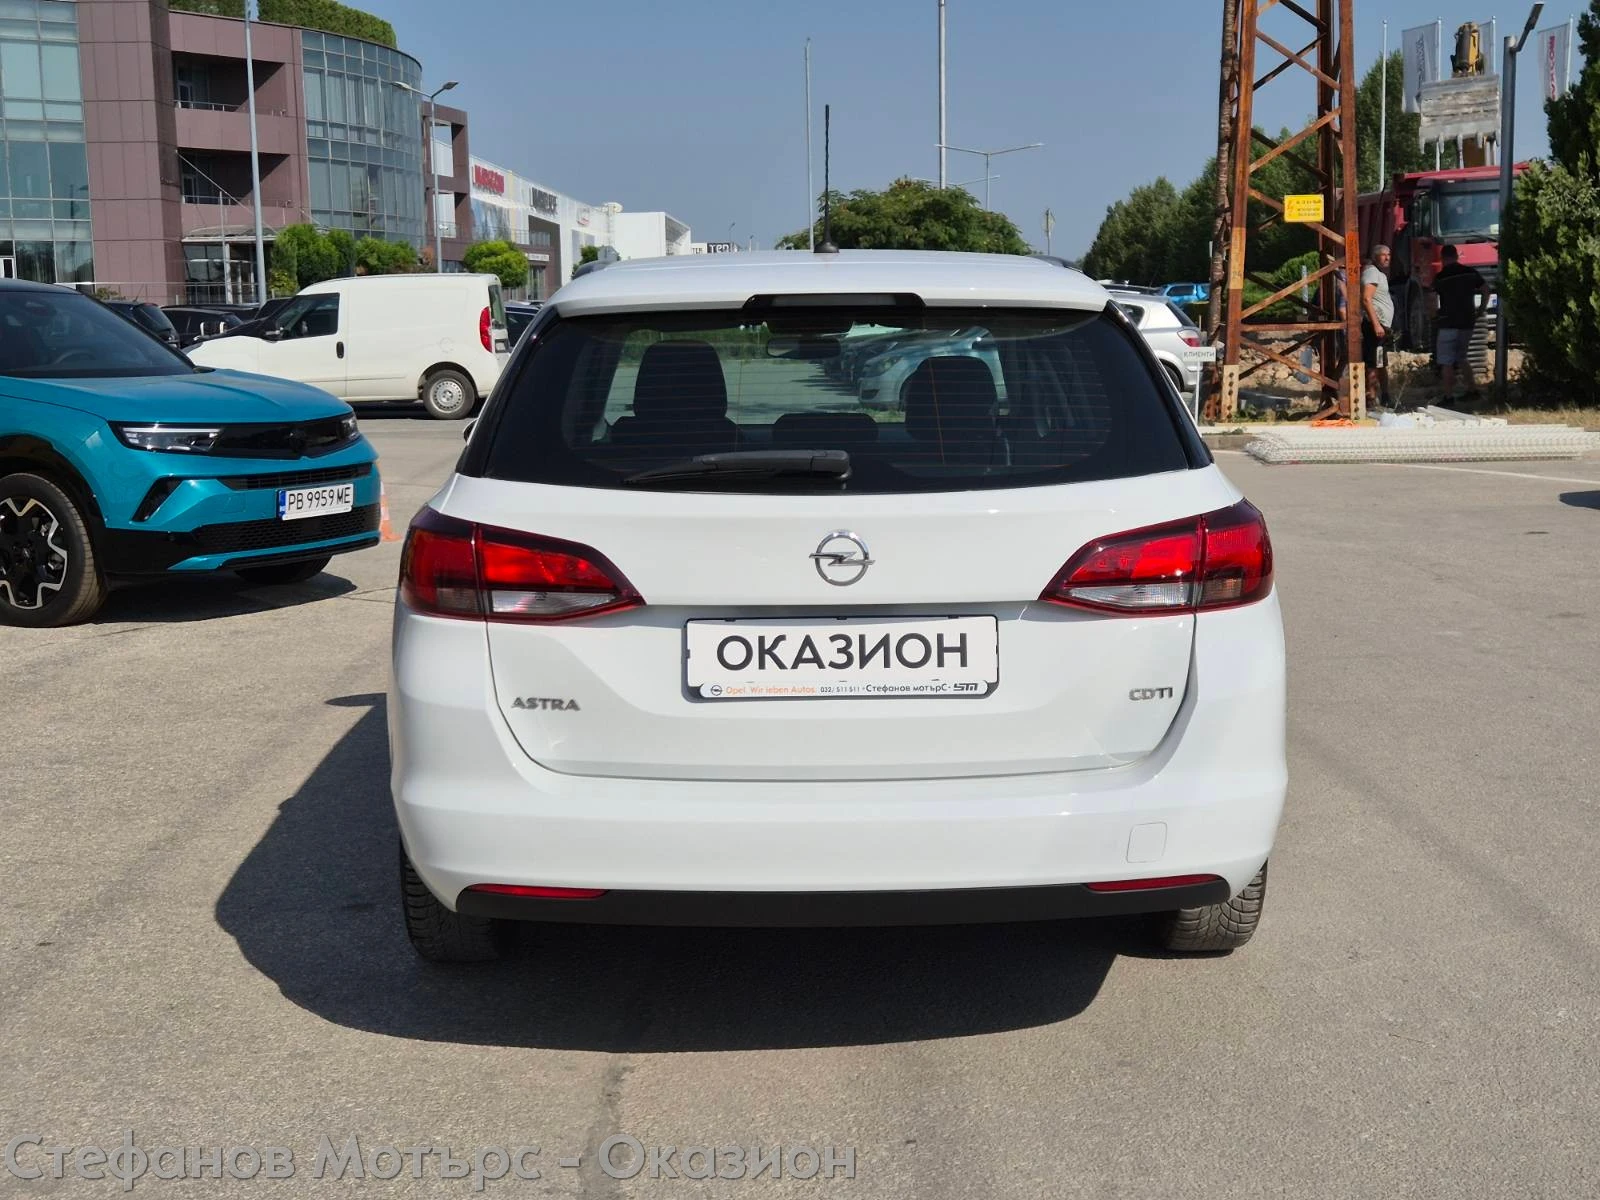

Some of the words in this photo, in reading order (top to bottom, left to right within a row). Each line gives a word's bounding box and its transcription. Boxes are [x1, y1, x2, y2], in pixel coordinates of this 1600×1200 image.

[717, 632, 968, 671] ОКАЗИОН
[866, 684, 910, 693] Стефанов
[511, 697, 580, 711] ASTRA
